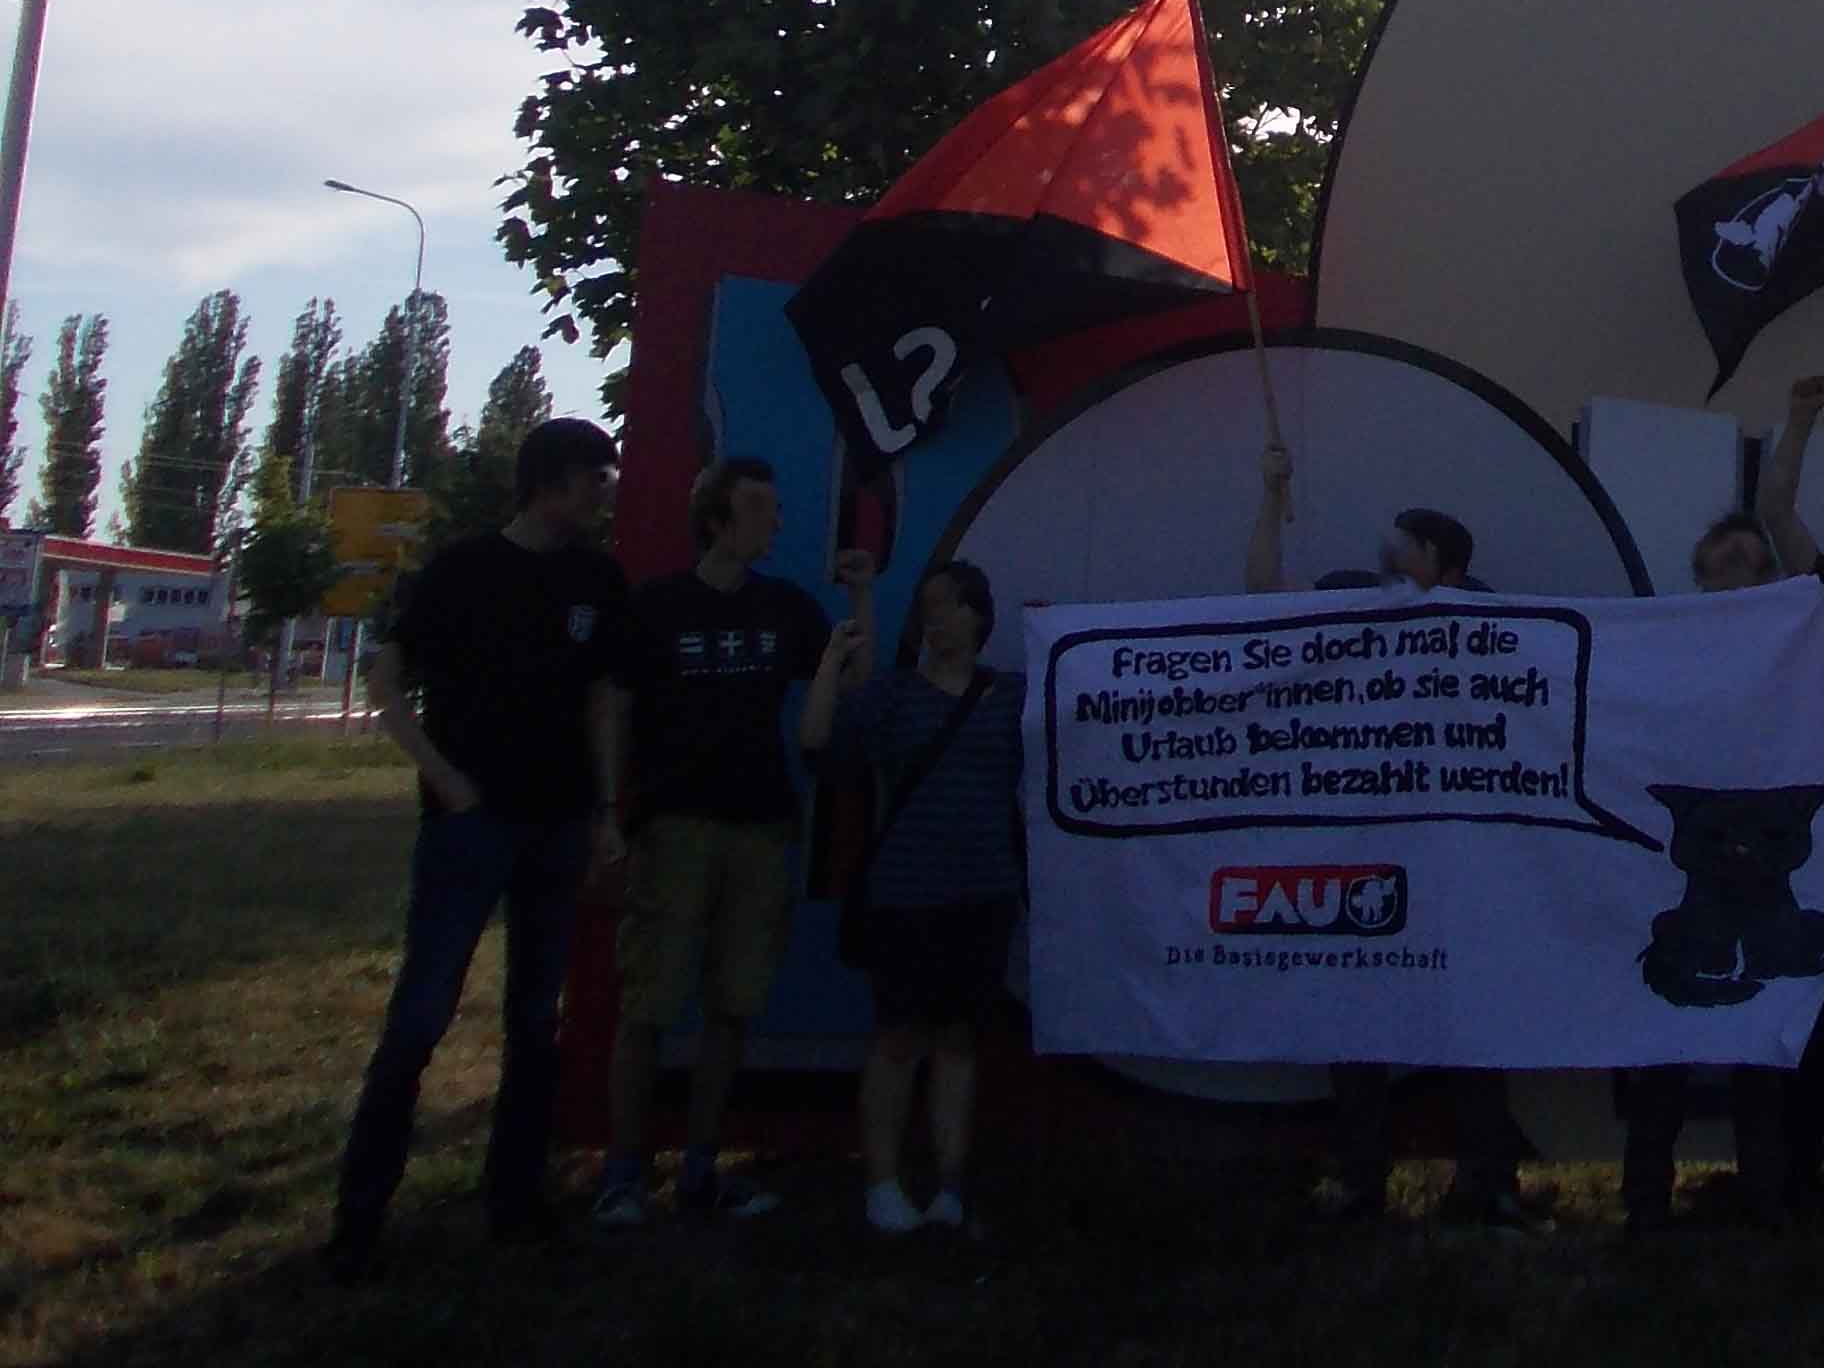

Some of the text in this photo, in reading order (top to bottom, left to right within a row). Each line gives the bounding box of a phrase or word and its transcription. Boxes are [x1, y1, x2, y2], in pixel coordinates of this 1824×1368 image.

[1112, 620, 1519, 680] Fragen Sie doch mal die
[1413, 666, 1460, 699] sie
[1470, 666, 1549, 707] auch
[1122, 712, 1507, 762] Urlaub bekommen und
[1070, 760, 1568, 812] Überstunden bezahlt werden!
[1219, 879, 1344, 927] FAU
[1165, 946, 1204, 965] Die
